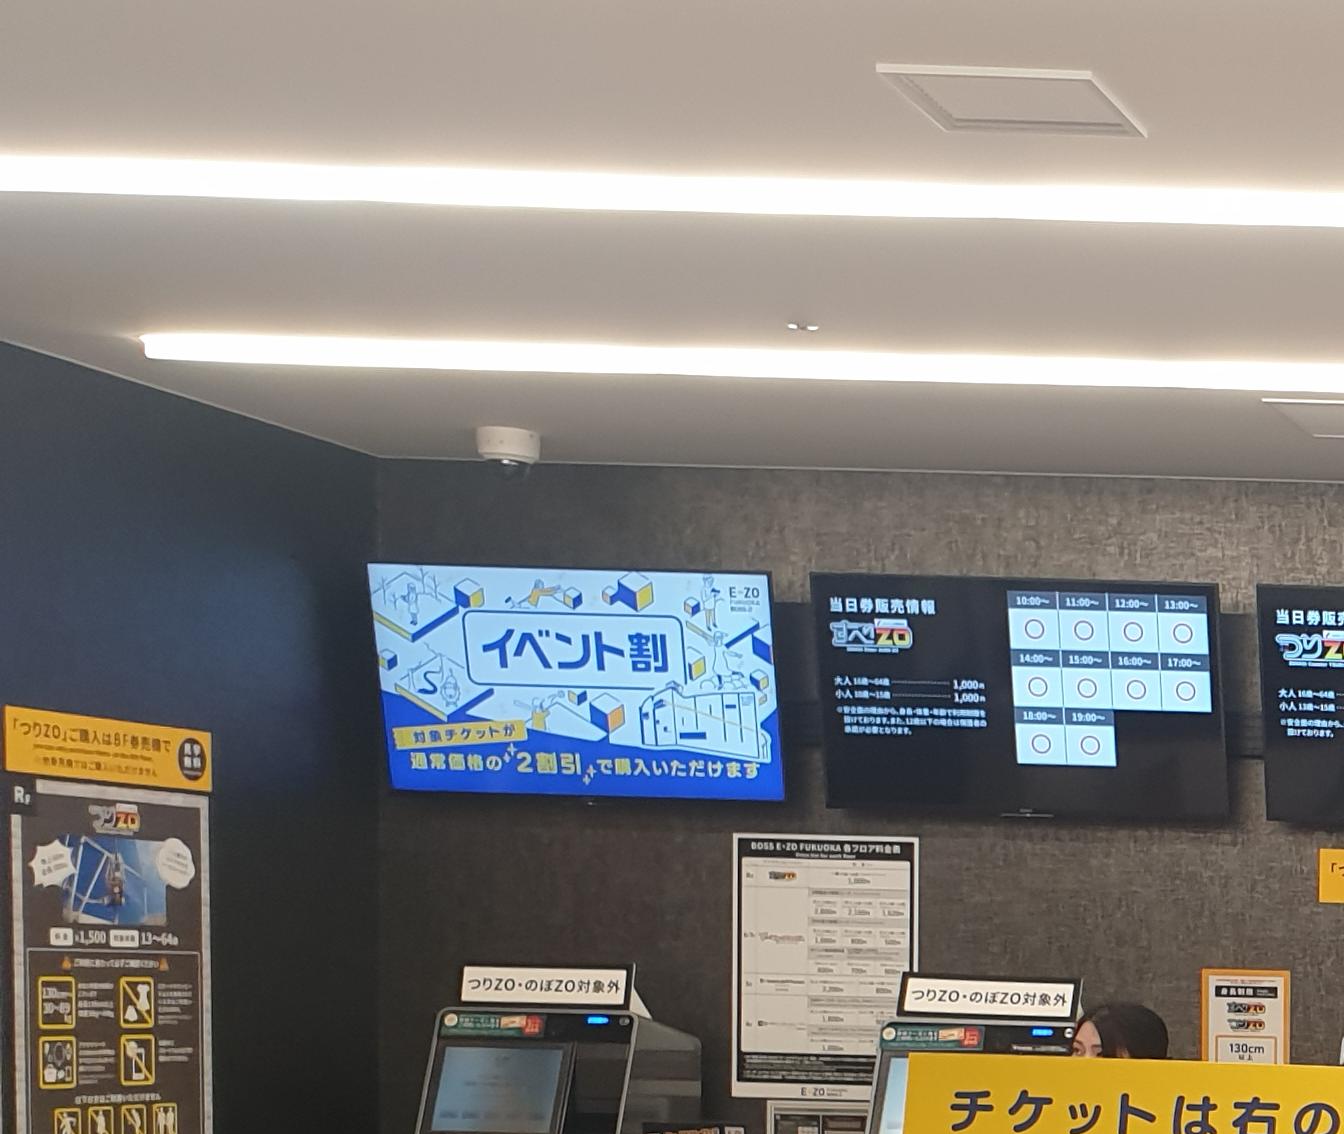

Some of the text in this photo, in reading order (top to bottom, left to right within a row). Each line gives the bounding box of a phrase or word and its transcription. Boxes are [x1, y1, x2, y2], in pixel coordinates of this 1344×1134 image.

[483, 629, 668, 672] イベント割
[467, 977, 621, 993] つりZO・のぼZO対象外
[912, 989, 1067, 1006] つりZO・のぼZO対象外
